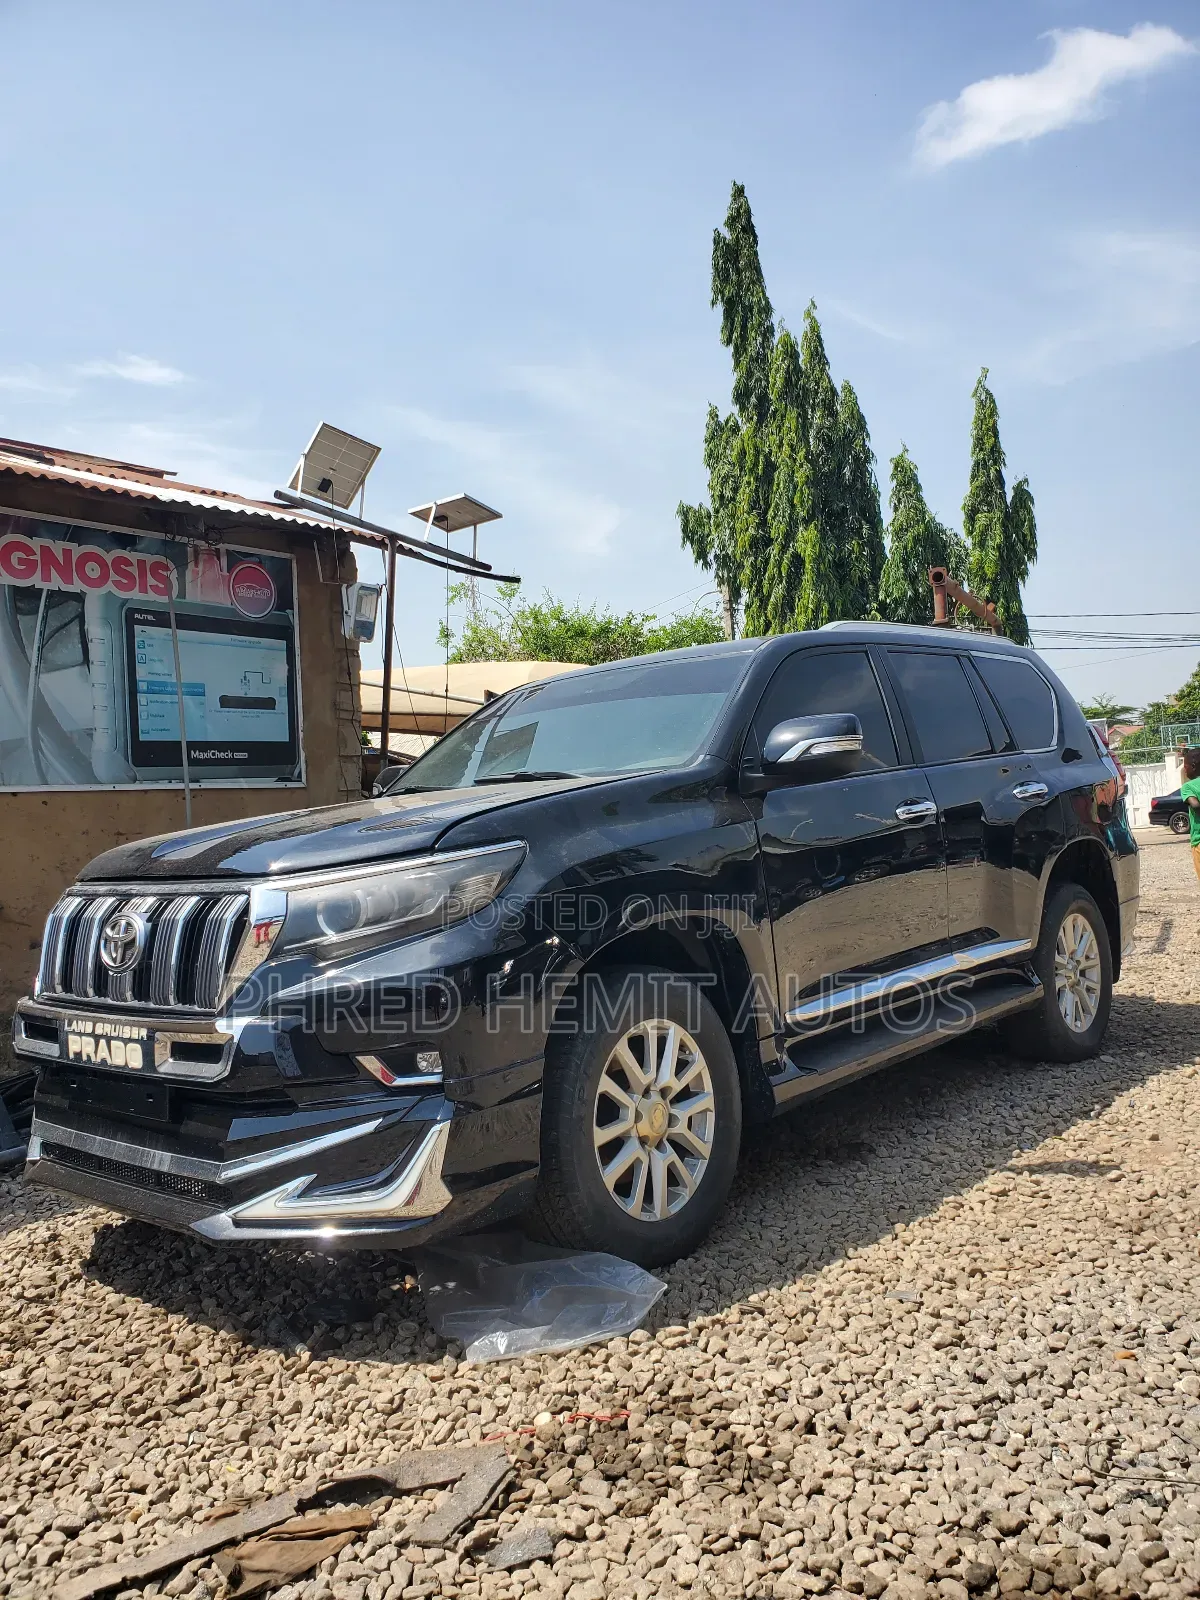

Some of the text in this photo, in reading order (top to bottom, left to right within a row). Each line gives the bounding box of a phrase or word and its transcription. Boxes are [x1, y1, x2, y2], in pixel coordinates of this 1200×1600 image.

[0, 540, 174, 597] GNOSIS
[134, 613, 156, 621] AUTEL
[191, 750, 233, 759] MaxiCheck
[64, 1019, 148, 1040] LAND CRUISER
[68, 1034, 143, 1069] PRADO
